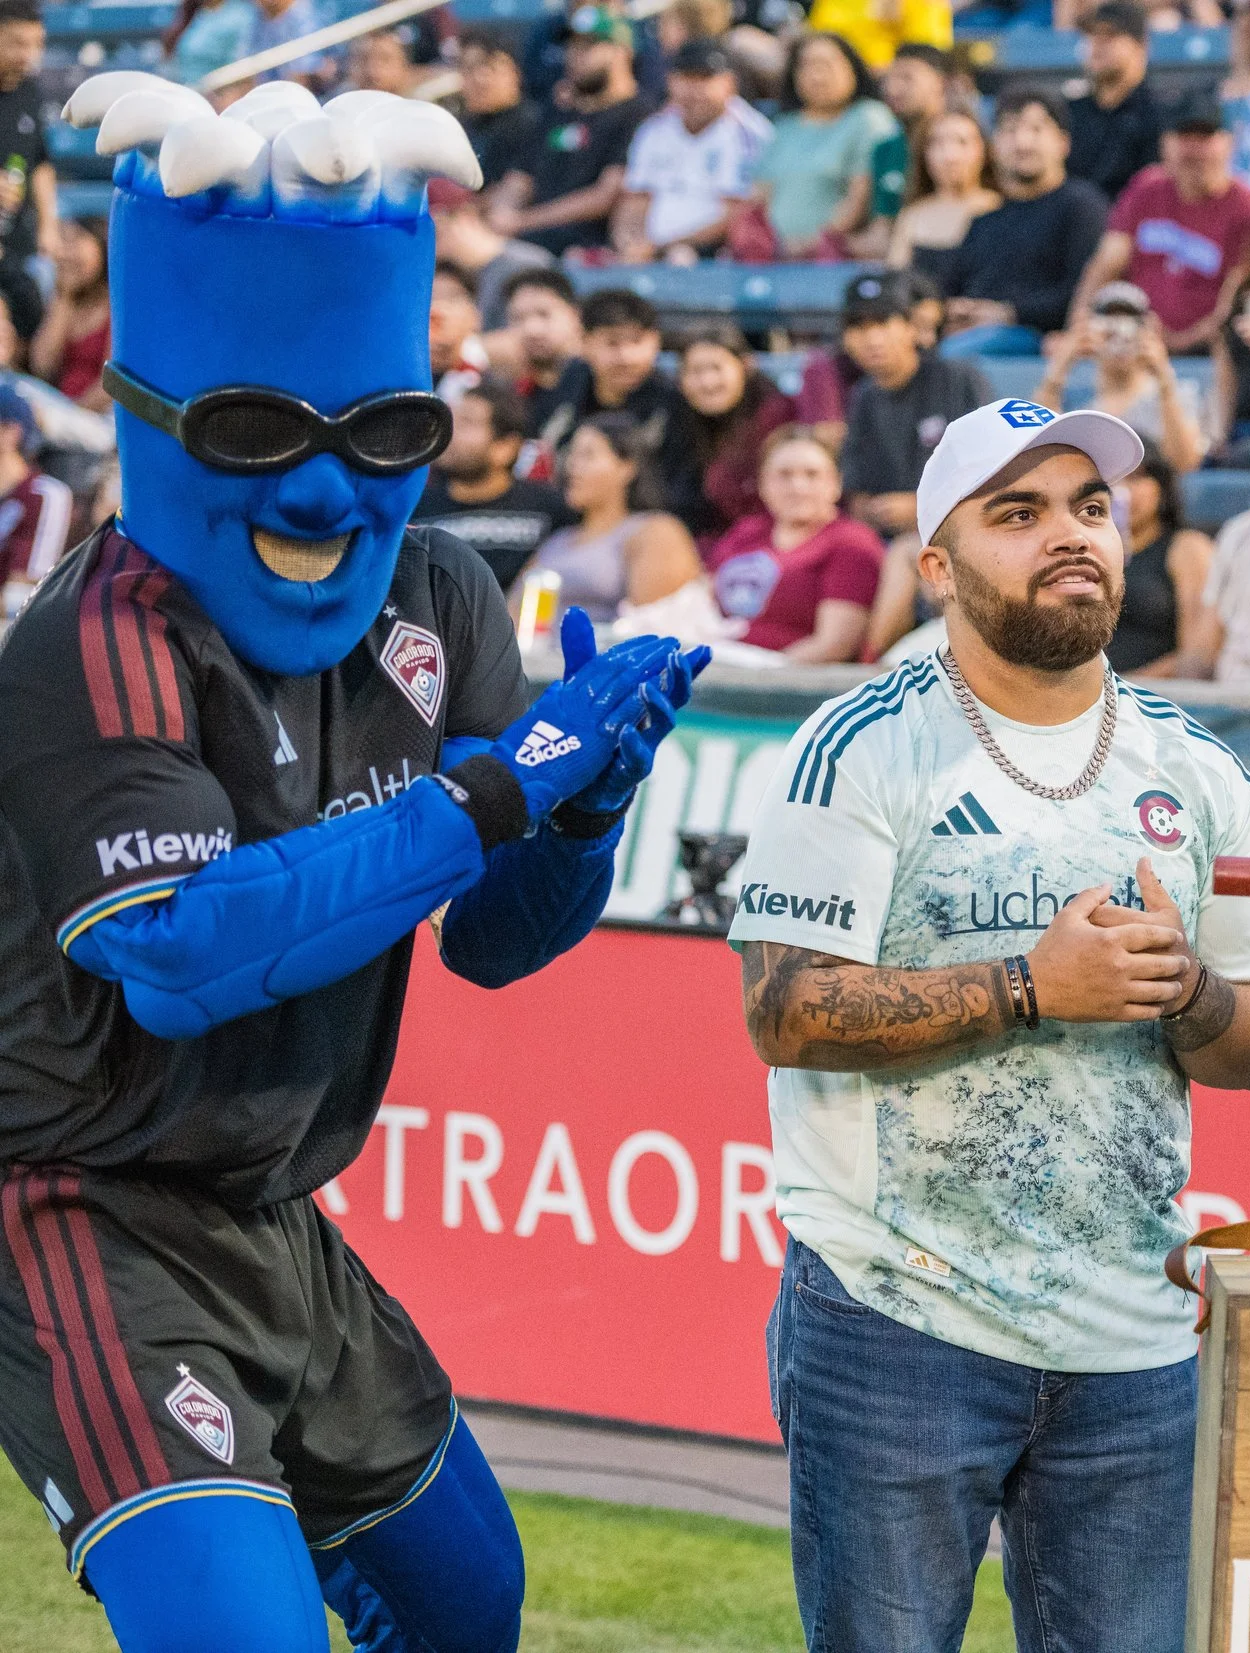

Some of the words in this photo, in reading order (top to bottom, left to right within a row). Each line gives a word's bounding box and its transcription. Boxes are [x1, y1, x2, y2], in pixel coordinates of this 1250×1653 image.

[393, 644, 436, 669] COLORADO
[515, 735, 582, 767] adidas
[317, 758, 423, 824] ealth
[736, 883, 857, 931] Kiewit
[314, 1104, 785, 1267] TRAOR
